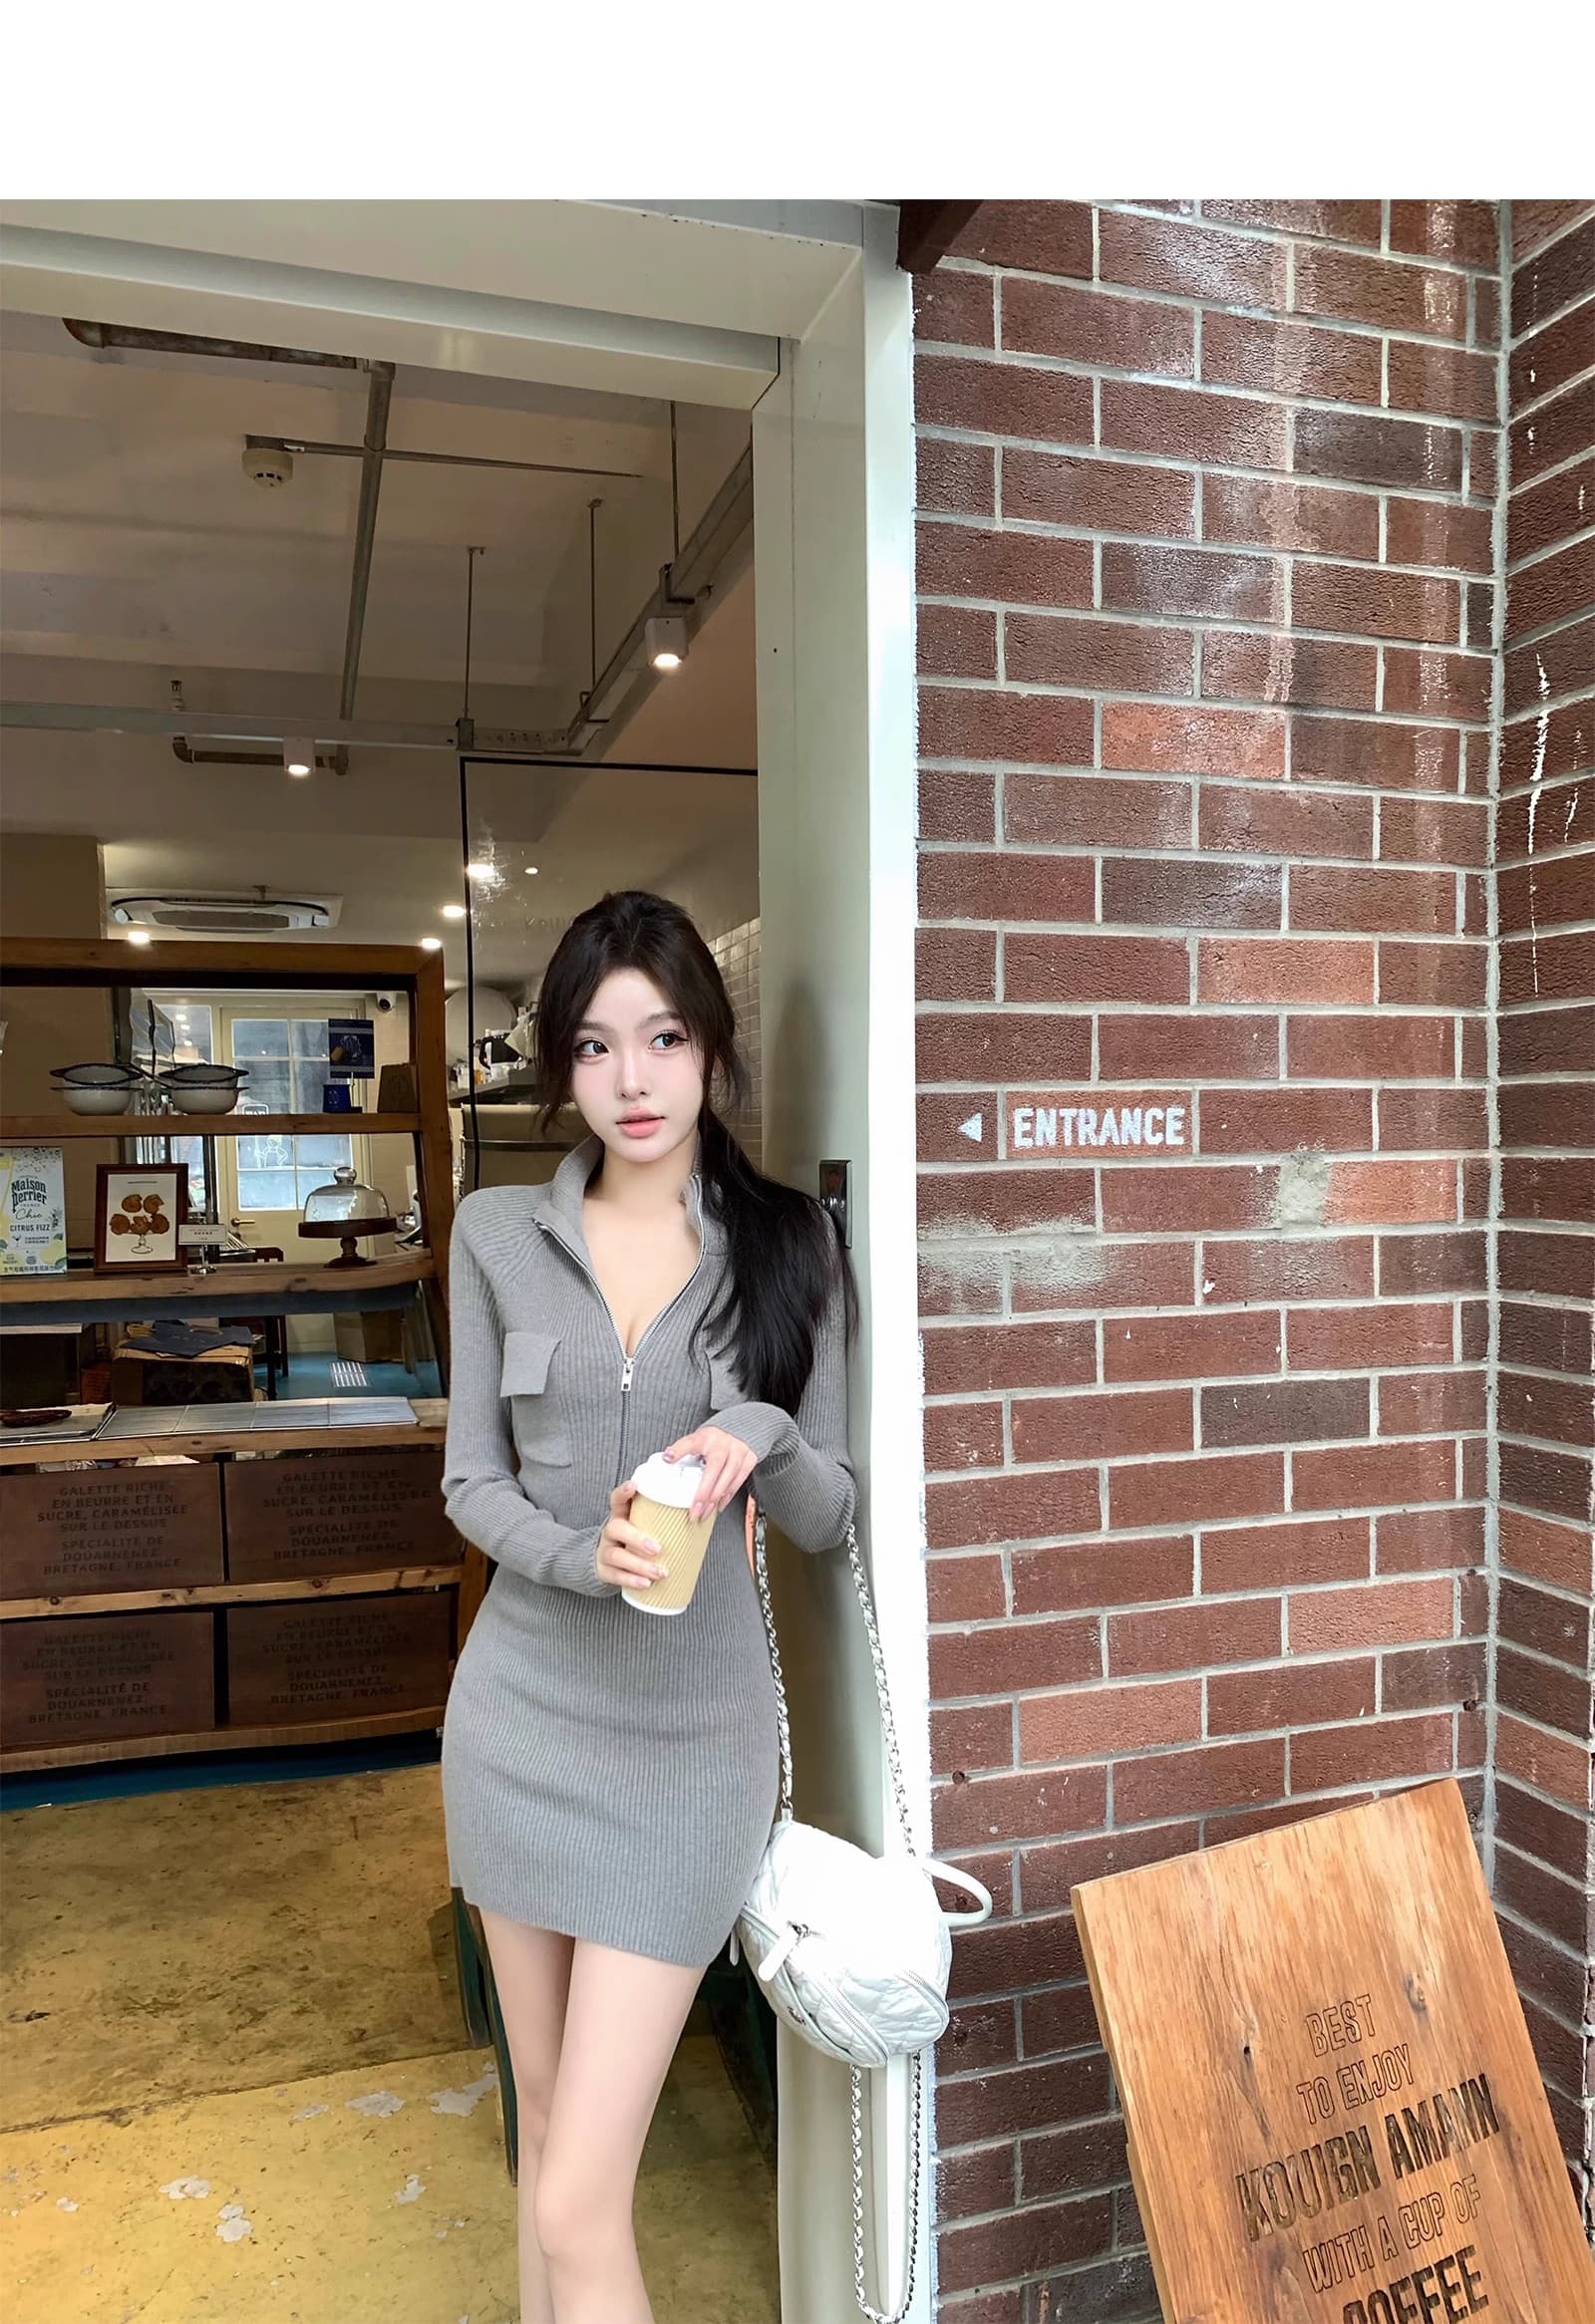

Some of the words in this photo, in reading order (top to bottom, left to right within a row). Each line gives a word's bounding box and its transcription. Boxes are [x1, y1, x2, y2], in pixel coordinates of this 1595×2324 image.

[1013, 1106, 1185, 1148] ENTRANCE
[11, 1178, 47, 1194] Maison
[282, 1470, 344, 1482] GALETTE
[60, 1484, 120, 1495] GALETTE
[125, 1482, 165, 1492] RICHE
[52, 1499, 71, 1509] EN
[76, 1496, 130, 1508] BEURRE
[135, 1495, 150, 1505] ET
[157, 1494, 173, 1505] EN
[286, 1506, 314, 1517] SUR
[319, 1506, 337, 1516] LE
[61, 1522, 88, 1533] SUR
[93, 1521, 113, 1531] LE
[114, 1518, 168, 1530] DESSUS
[379, 1519, 399, 1528] DE
[147, 1536, 163, 1546] DE
[127, 1558, 180, 1571] FRANCE
[132, 1682, 151, 1692] DE
[111, 1705, 168, 1717] FRANCE
[1305, 1993, 1376, 2058] BEST
[1296, 2076, 1336, 2126] TO
[1336, 2043, 1415, 2111] ENJOY
[1234, 2124, 1383, 2242] KOUIGN
[1385, 2073, 1500, 2180] AMANN
[1302, 2224, 1376, 2294] WITH
[1377, 2215, 1400, 2262] A
[1398, 2191, 1445, 2250] CUP
[1449, 2173, 1482, 2224] OF
